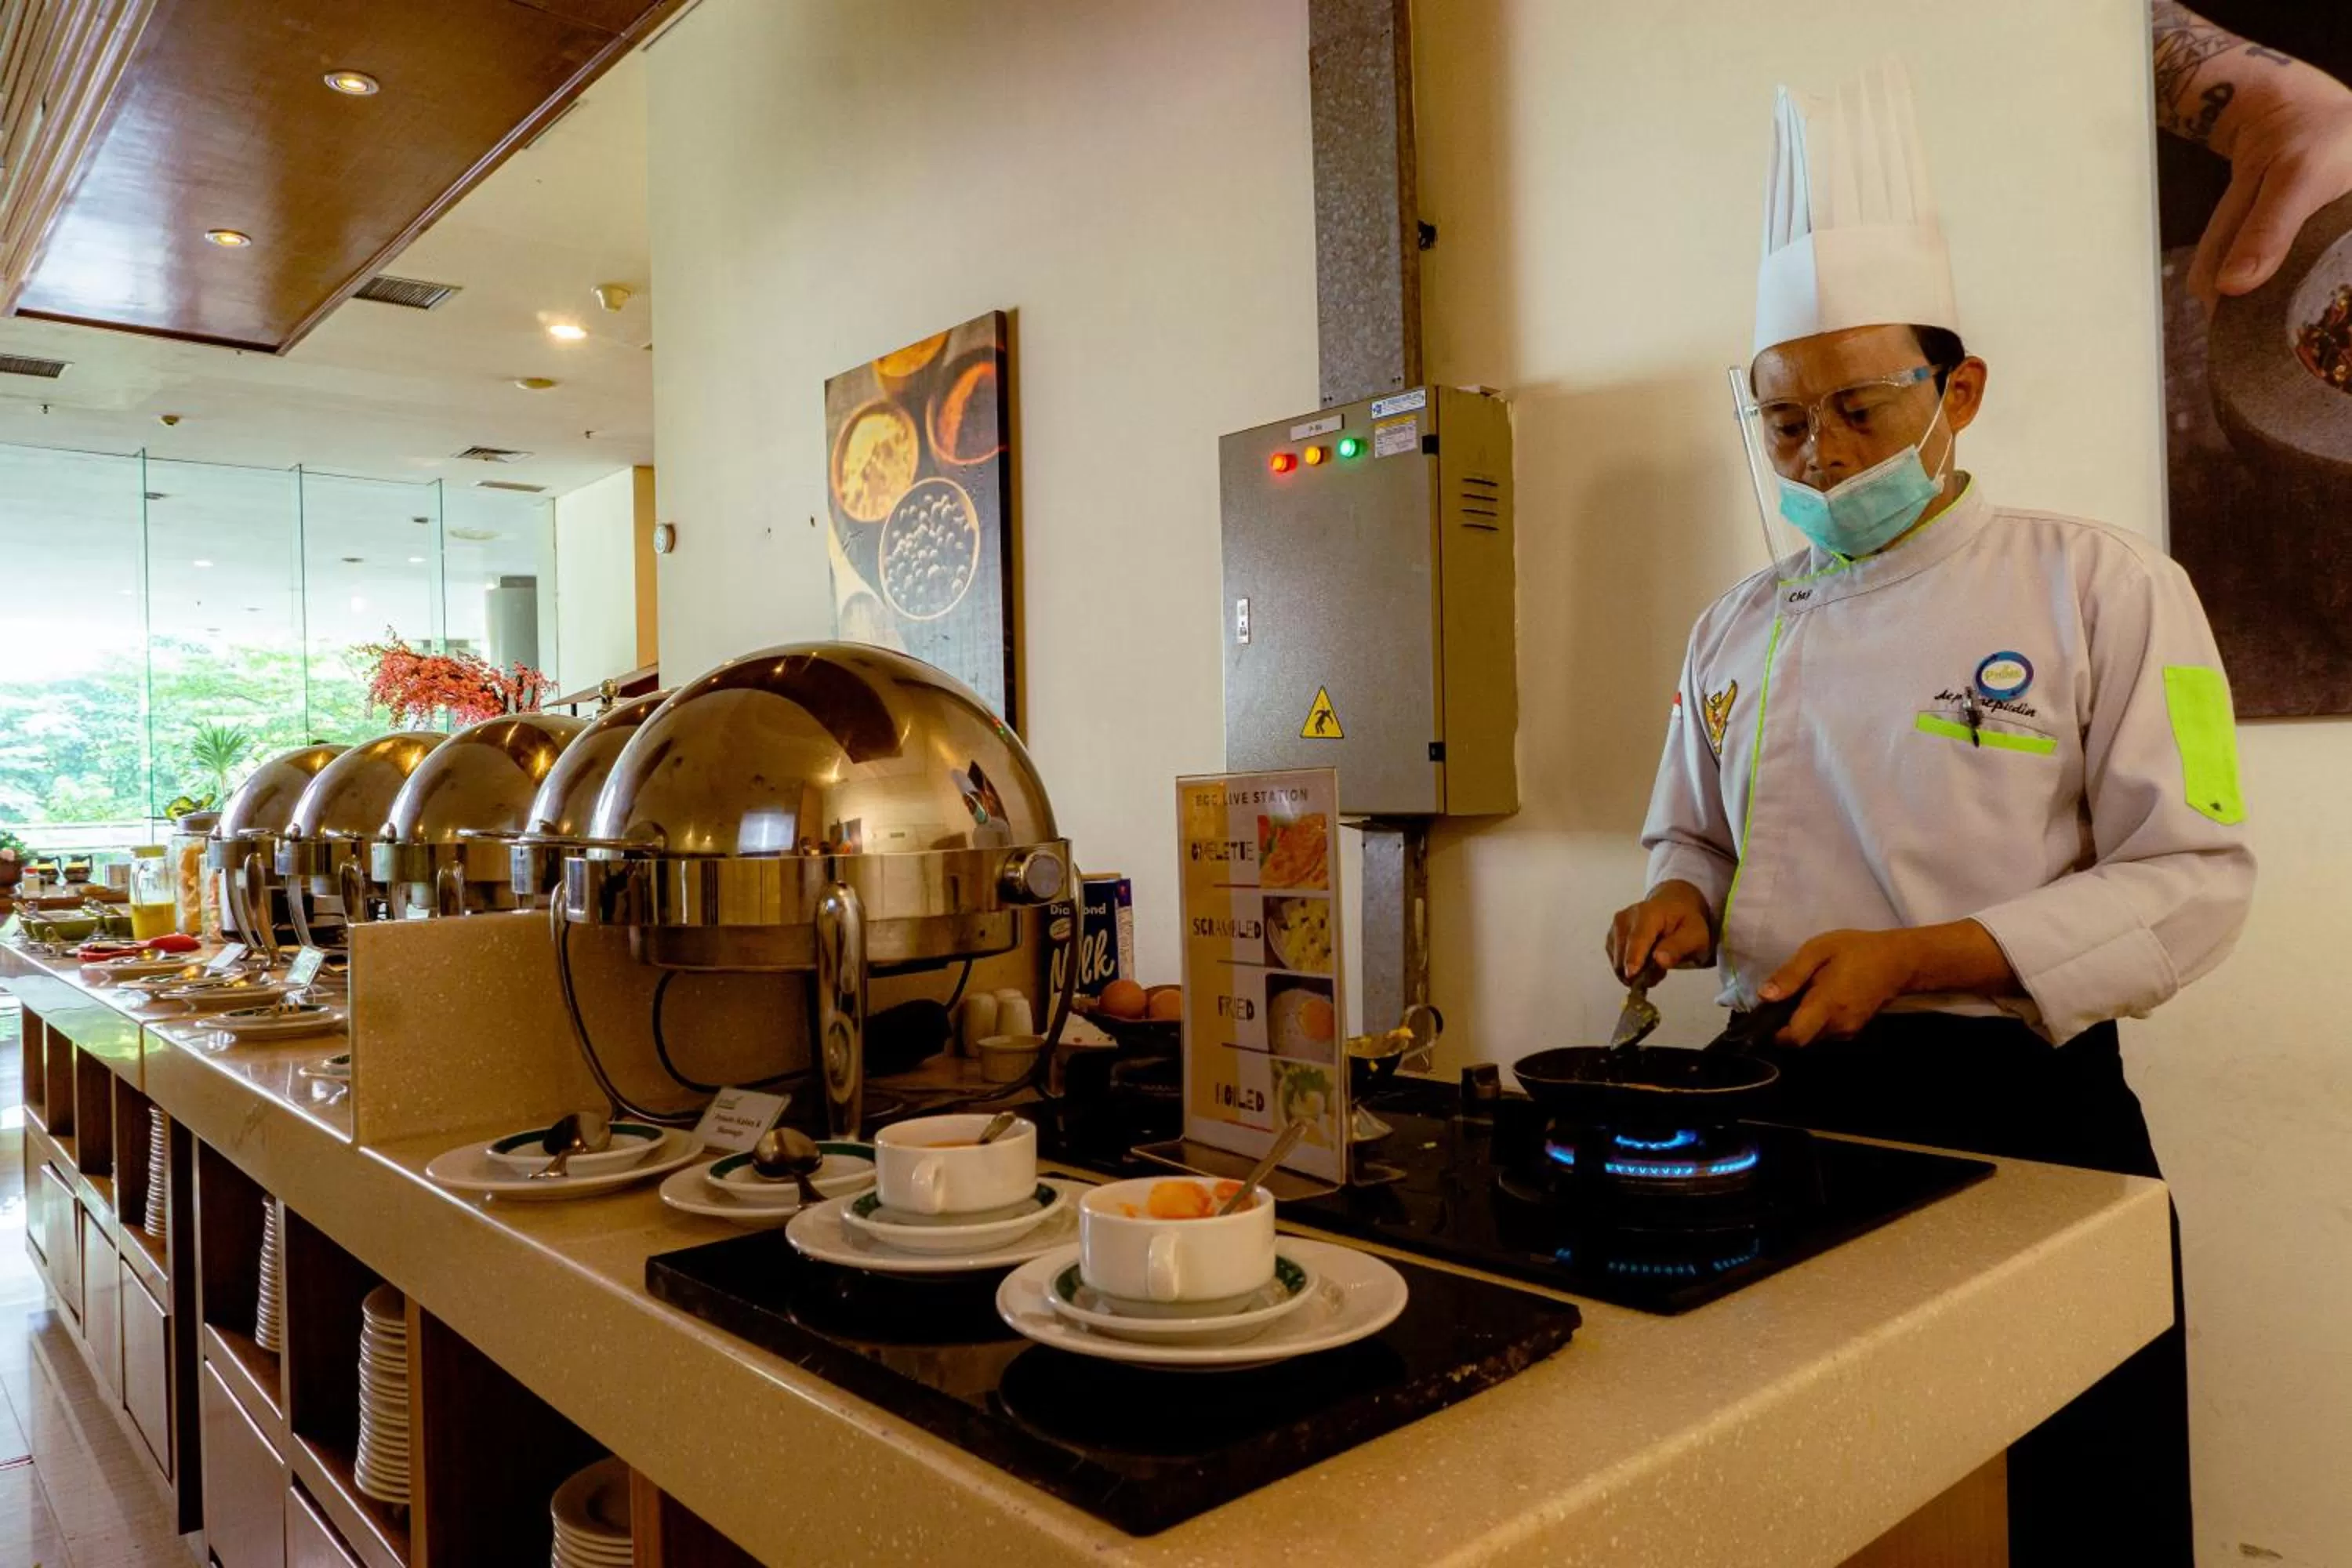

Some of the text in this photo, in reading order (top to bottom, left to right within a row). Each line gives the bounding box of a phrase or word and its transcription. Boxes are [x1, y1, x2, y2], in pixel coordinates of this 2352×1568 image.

[1222, 791, 1249, 806] LIVE
[1253, 788, 1308, 804] STATION
[1050, 902, 1106, 915] Diaond
